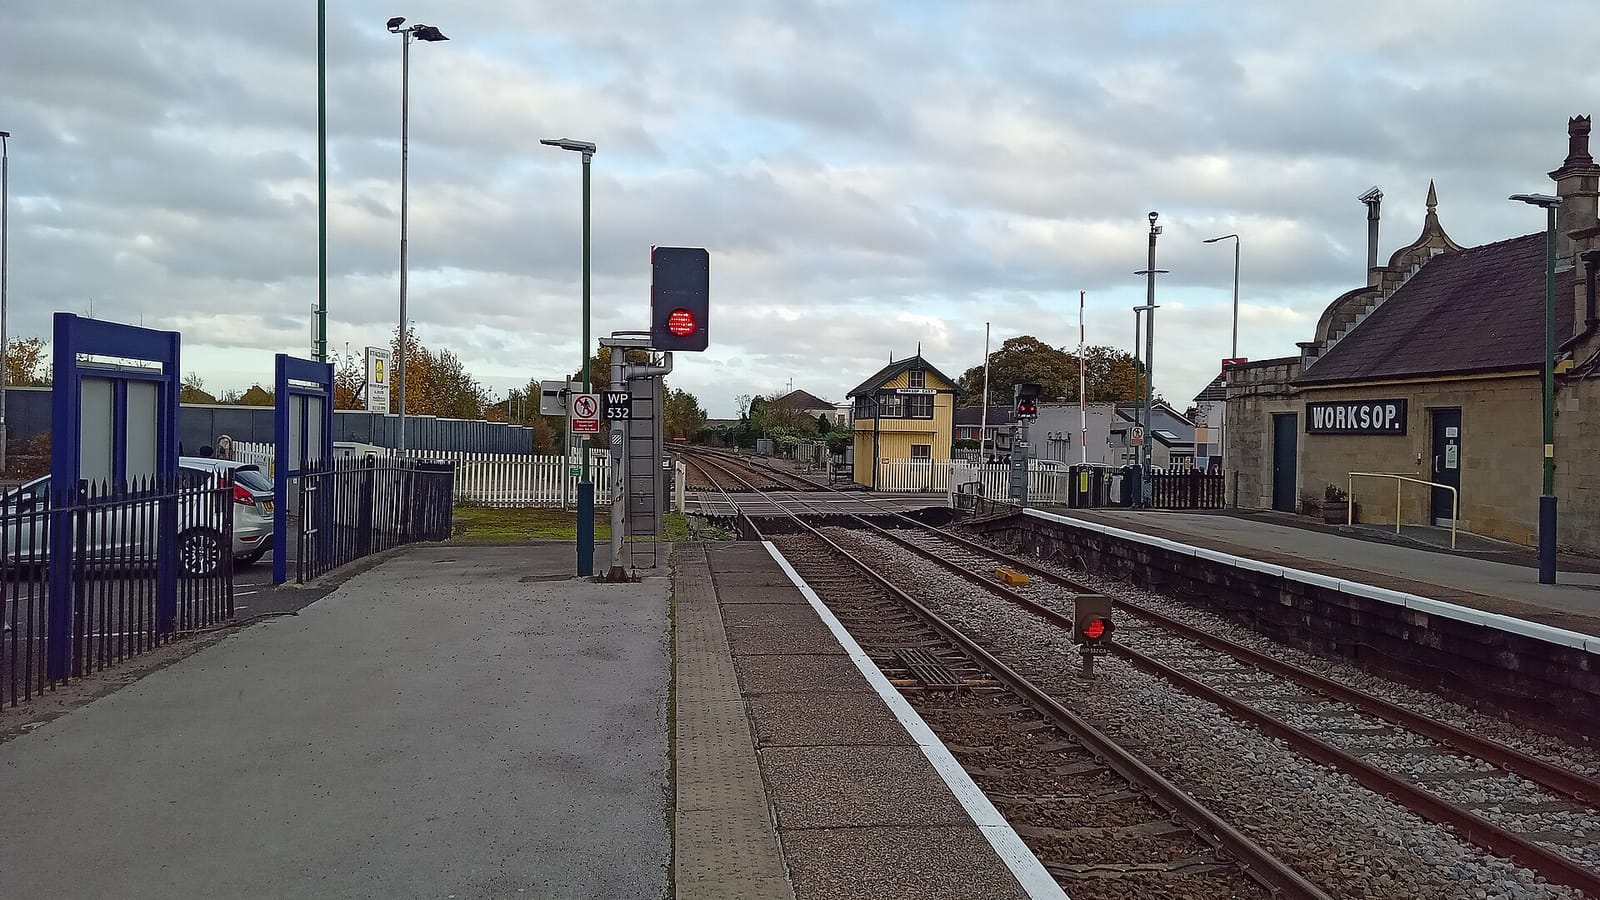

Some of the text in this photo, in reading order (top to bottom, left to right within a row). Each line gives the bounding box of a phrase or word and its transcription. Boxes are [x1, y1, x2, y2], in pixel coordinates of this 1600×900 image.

[608, 393, 628, 404] WP
[607, 407, 629, 419] 532
[1313, 404, 1400, 429] WORKSOP.
